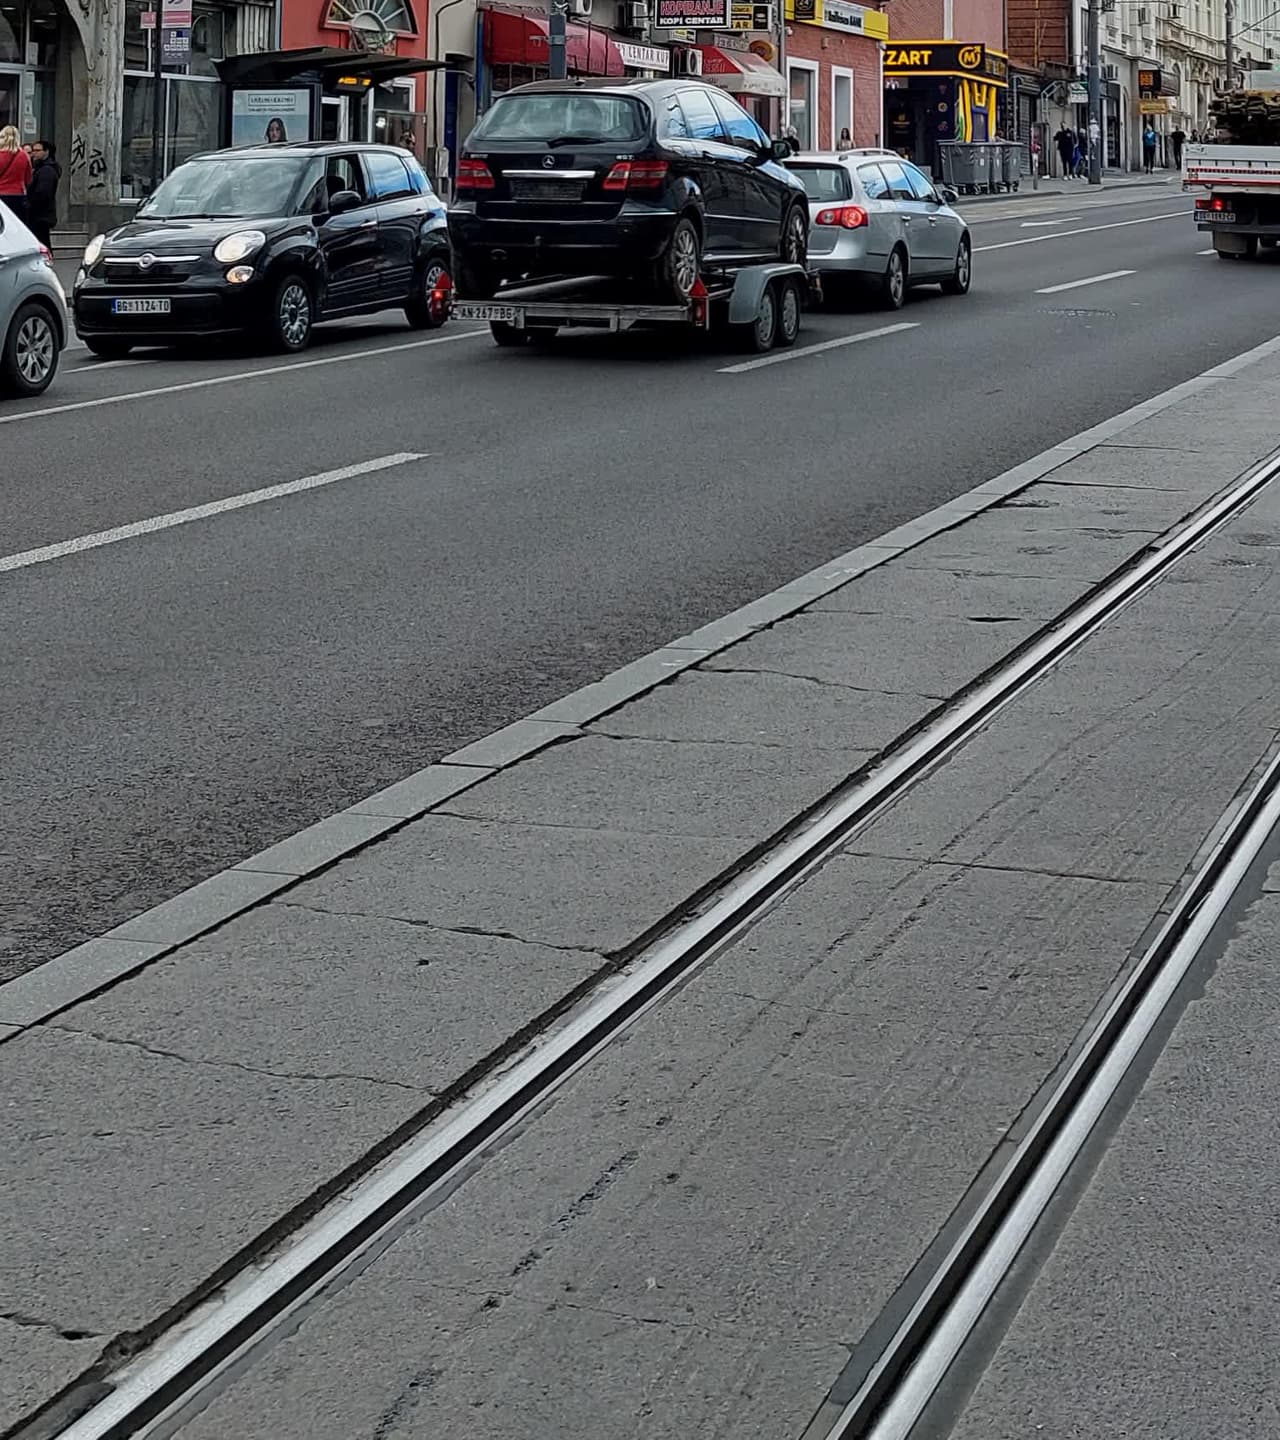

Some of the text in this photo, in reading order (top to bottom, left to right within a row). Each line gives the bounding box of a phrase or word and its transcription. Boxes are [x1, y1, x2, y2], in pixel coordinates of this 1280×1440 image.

[660, 0, 724, 16] KOPIRANJE
[660, 16, 724, 25] KOPI CENTAR
[883, 50, 933, 66] ZART
